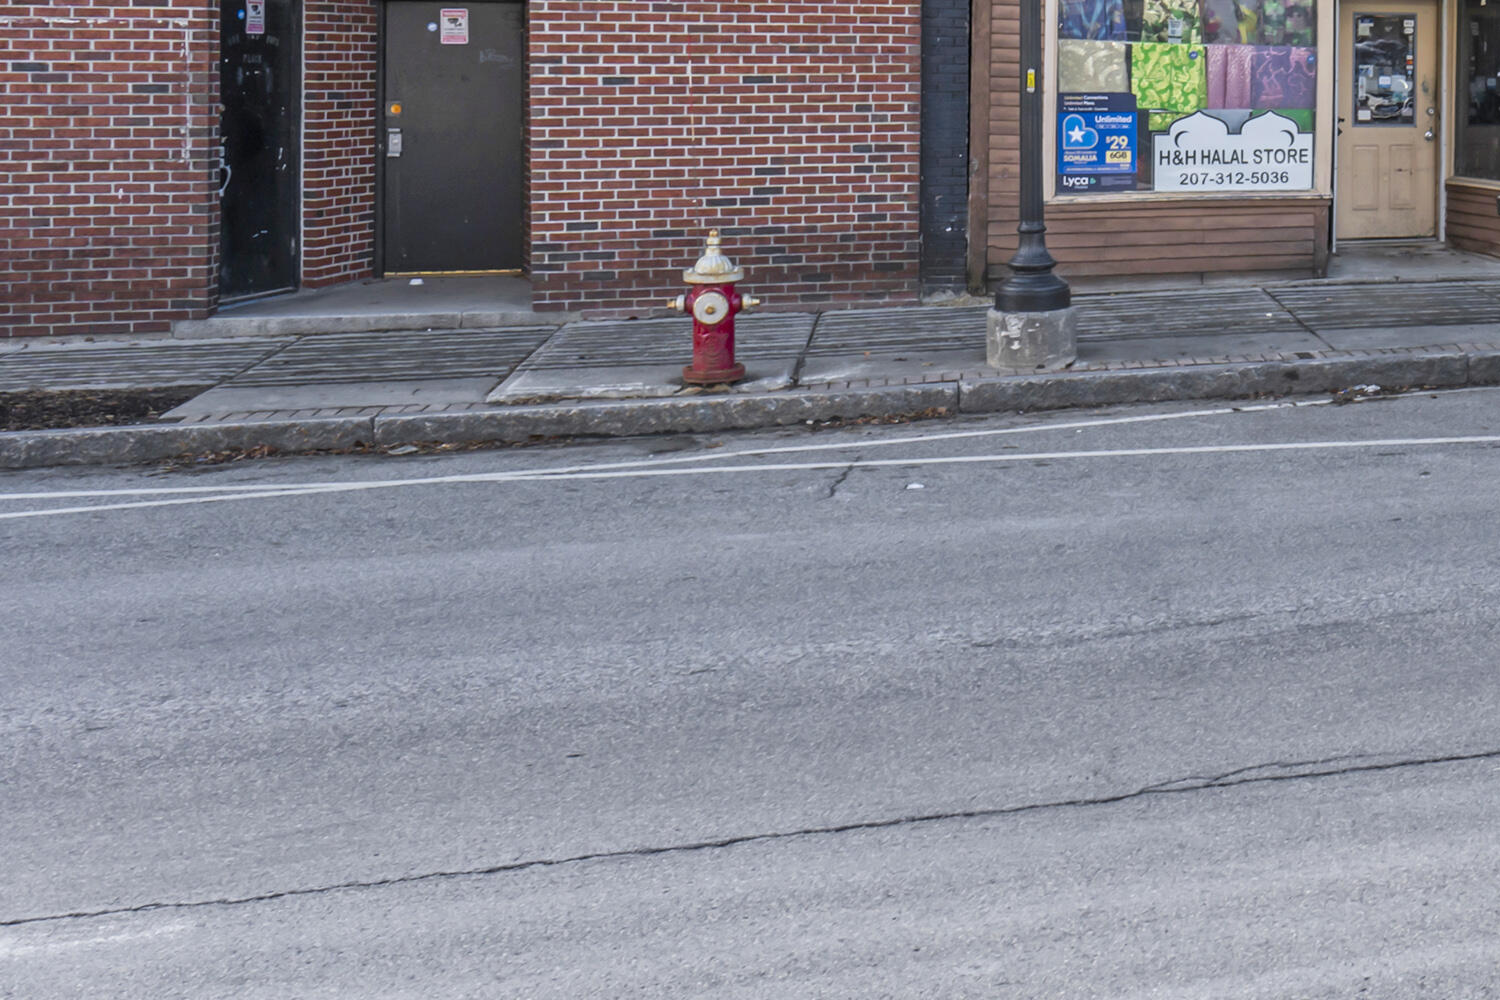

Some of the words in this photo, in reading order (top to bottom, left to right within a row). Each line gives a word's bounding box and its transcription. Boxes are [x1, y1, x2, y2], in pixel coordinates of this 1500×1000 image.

[1095, 115, 1132, 123] Unlimited
[1105, 135, 1128, 149] $29
[1109, 151, 1127, 159] 6GB
[1159, 150, 1197, 165] H&H
[1201, 150, 1248, 165] HALAL
[1253, 149, 1309, 164] STORE
[1063, 175, 1088, 187] Lyca
[1179, 171, 1289, 185] 207-312-5036
